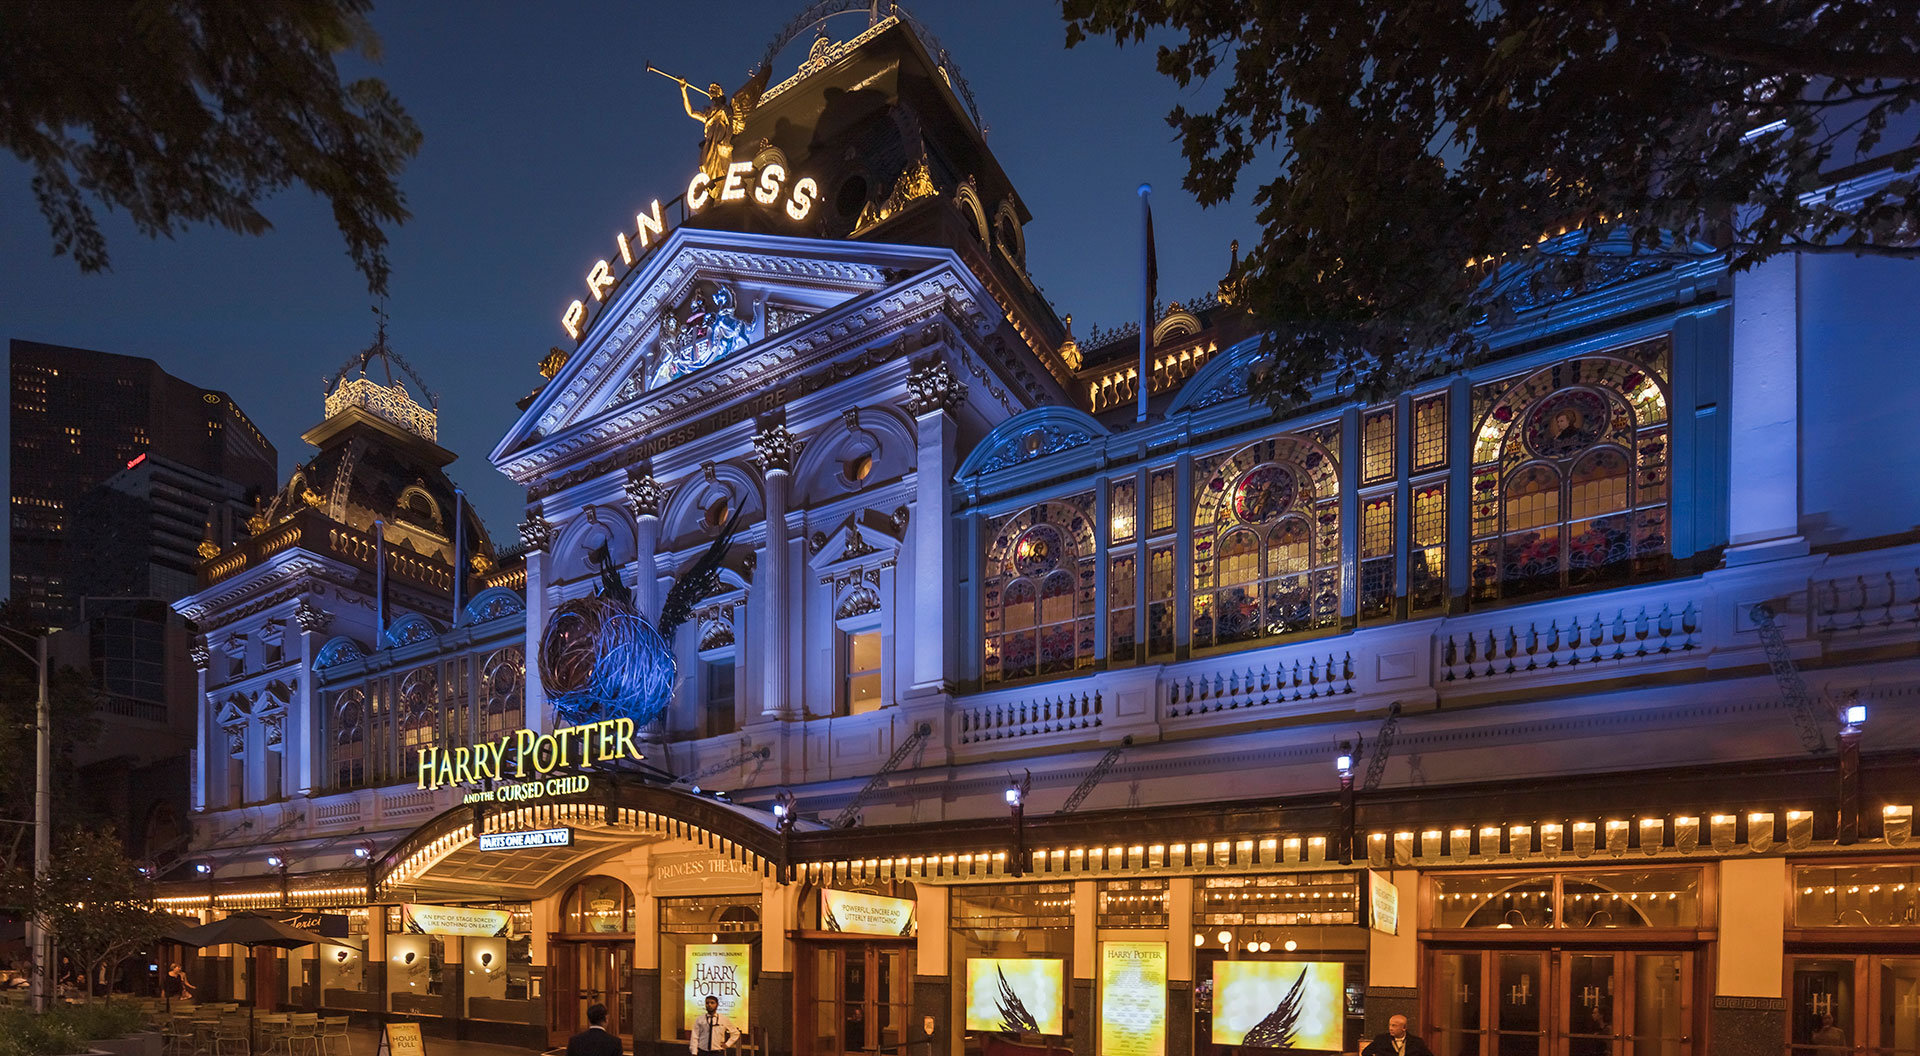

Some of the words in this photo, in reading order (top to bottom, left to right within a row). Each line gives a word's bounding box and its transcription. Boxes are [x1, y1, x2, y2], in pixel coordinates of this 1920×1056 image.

[561, 161, 818, 339] PRINCESS
[709, 388, 787, 430] THEATRE
[228, 402, 267, 449] SOFITEL
[416, 736, 510, 791] HARRY
[515, 717, 644, 778] POTTER
[463, 793, 480, 804] AND
[479, 791, 494, 802] THE
[497, 782, 544, 802] CURSED
[546, 775, 589, 794] CHILD
[482, 837, 505, 849] PARTS
[505, 836, 524, 846] ONE
[524, 833, 544, 845] AND
[544, 831, 567, 844] TWO
[657, 860, 704, 881] PRINCESS
[708, 859, 753, 874] THEATRE
[845, 913, 866, 922] UTTERLY
[871, 907, 890, 915] SINCERE
[890, 909, 900, 917] AND
[1108, 950, 1132, 959] HARRY
[1134, 950, 1162, 959] POTTER
[696, 963, 738, 981] HARRY
[693, 979, 740, 997] POTTER
[1584, 986, 1599, 1007] H
[1812, 993, 1832, 1015] H
